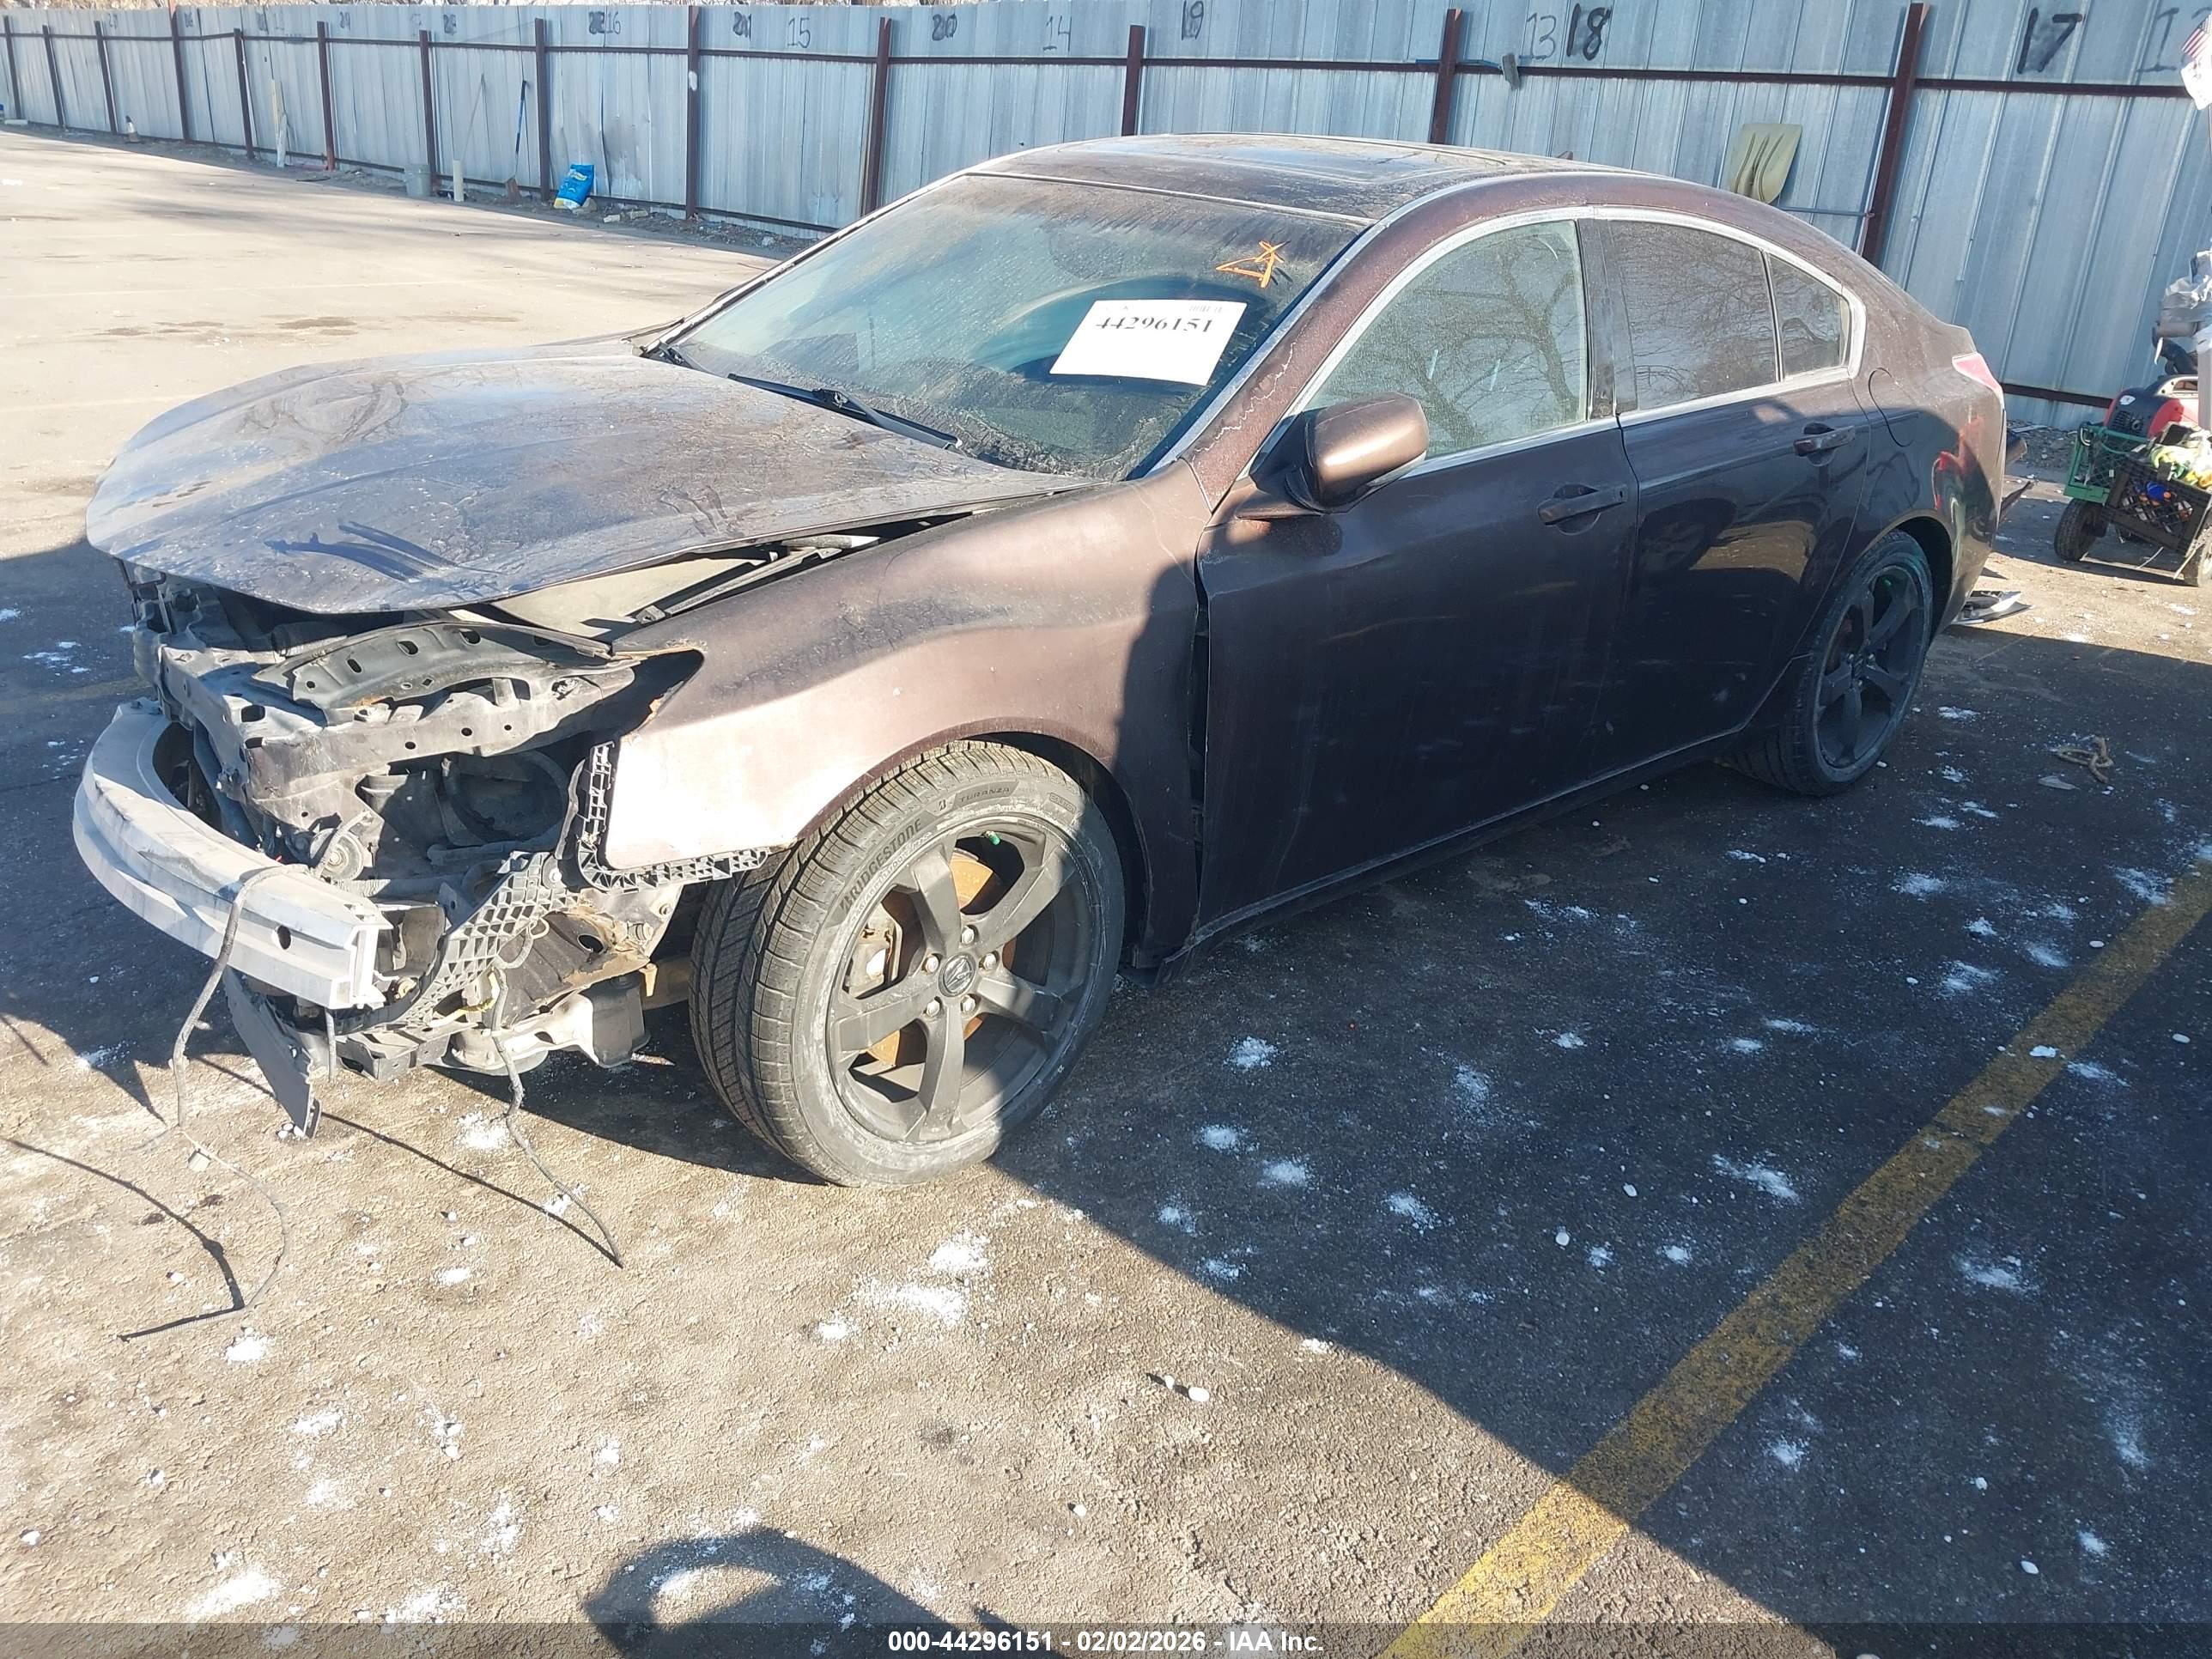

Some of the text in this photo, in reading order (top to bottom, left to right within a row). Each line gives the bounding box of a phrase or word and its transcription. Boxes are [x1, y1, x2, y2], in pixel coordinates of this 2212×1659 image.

[787, 17, 811, 48] 15
[1042, 15, 1072, 52] 14
[1182, 0, 1204, 40] 19
[1519, 12, 1557, 60] 13
[1566, 3, 1612, 61] 18
[2017, 7, 2083, 74] 17
[1096, 316, 1212, 332] 44296151
[960, 787, 1011, 803] TURANZA
[840, 817, 922, 915] BRIDGESTONE
